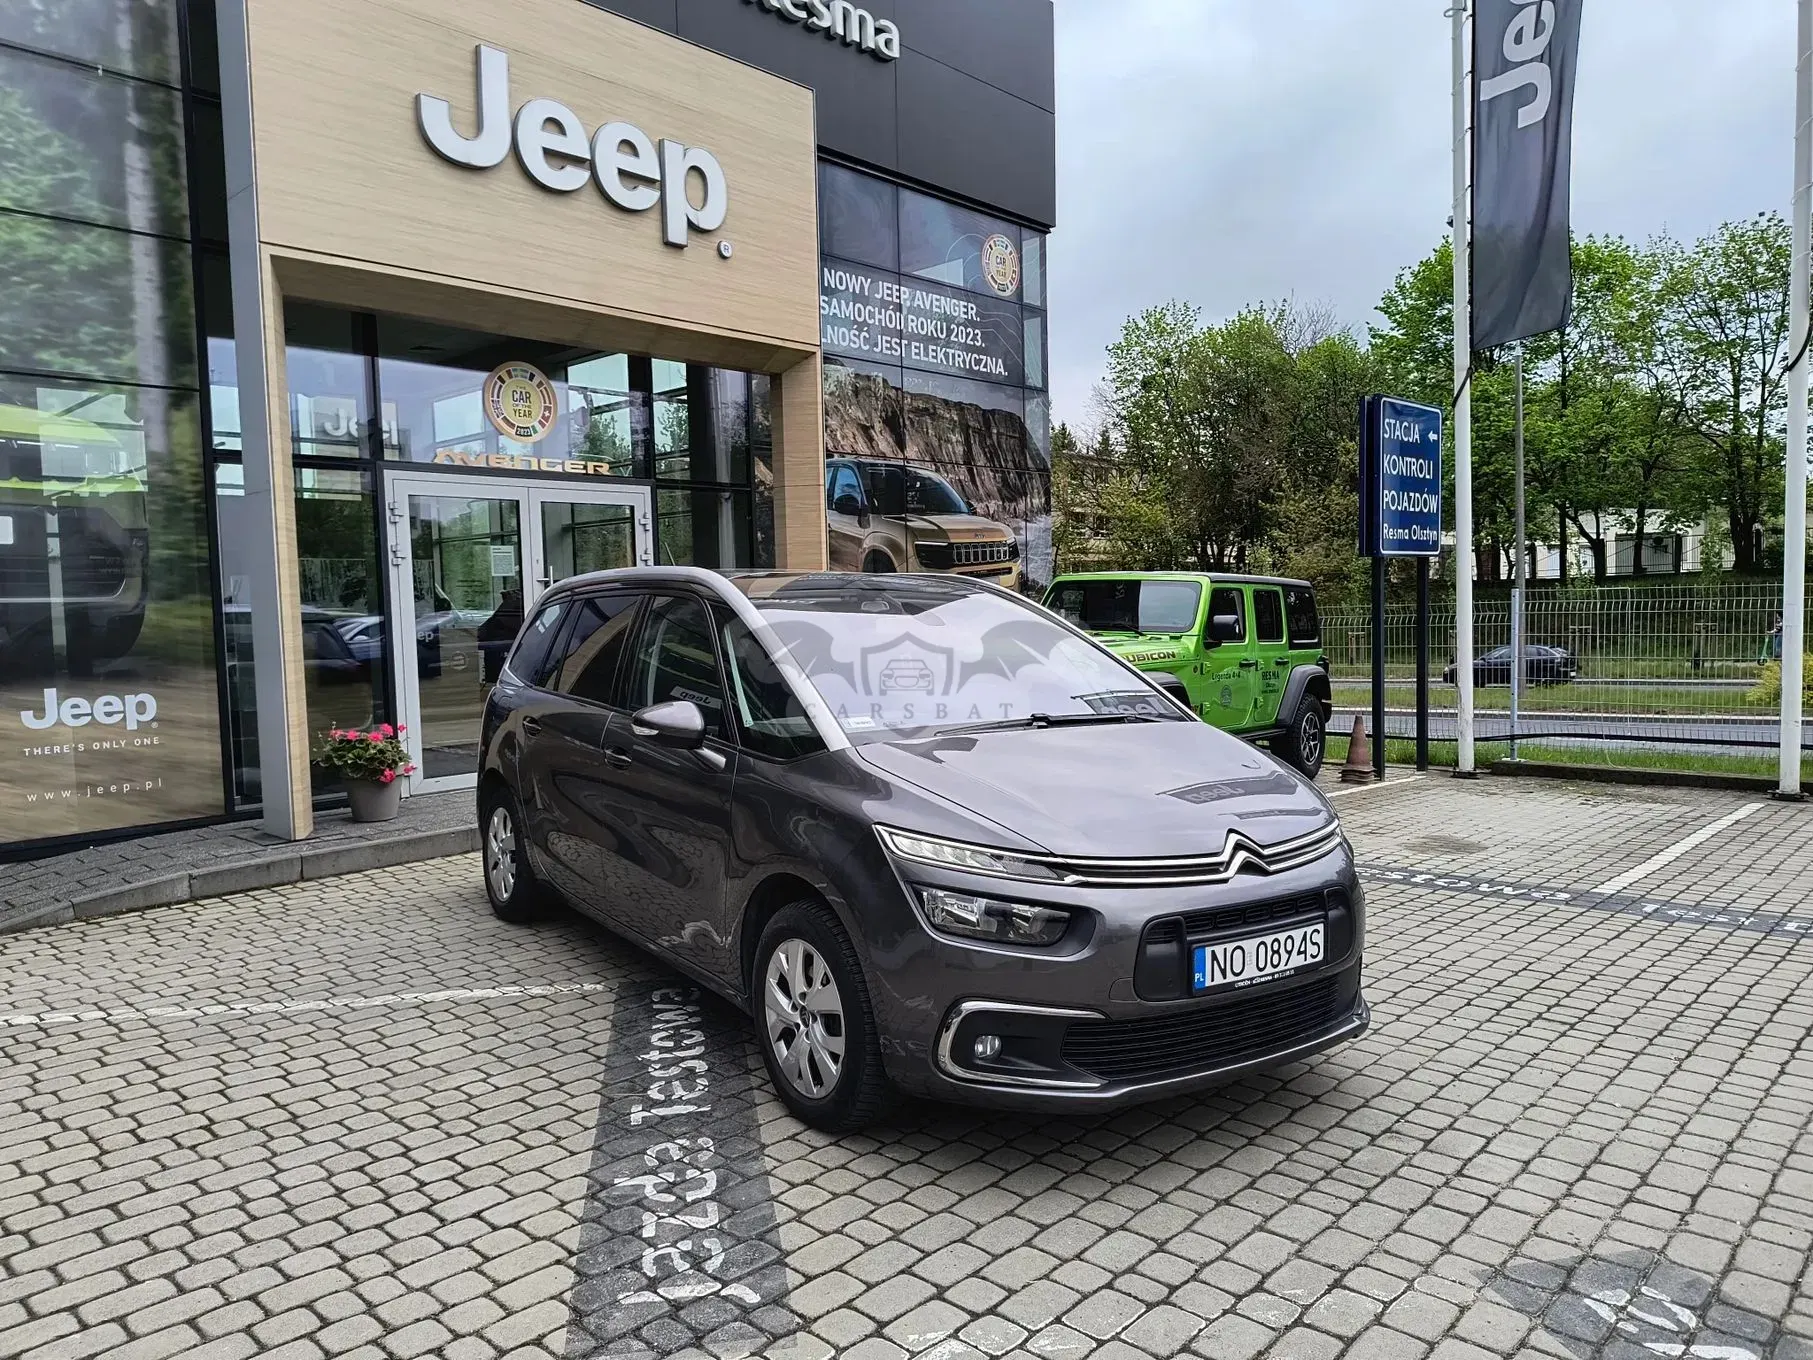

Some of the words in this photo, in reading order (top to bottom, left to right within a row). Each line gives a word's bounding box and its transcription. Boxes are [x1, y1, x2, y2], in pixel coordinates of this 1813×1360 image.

[742, 0, 899, 59] esma
[1480, 0, 1555, 129] Je
[415, 44, 728, 248] Jeep
[823, 267, 872, 296] NOWY
[913, 290, 980, 322] AVENGER.
[908, 314, 947, 339] ROKU
[950, 324, 985, 348] 2023.
[873, 334, 908, 358] JEST
[911, 341, 1008, 376] ELEKTRYCZNA.
[512, 389, 532, 404] CAR
[512, 408, 533, 419] YEAR
[1384, 418, 1420, 444] STACJA
[1383, 453, 1433, 480] KONTROLI
[1383, 488, 1438, 514] POJAZDÓW
[1383, 523, 1409, 541] Resma
[1411, 524, 1438, 545] Olsztyn
[20, 687, 157, 731] Jeep
[24, 743, 85, 757] THERE'S
[92, 739, 127, 750] ONLY
[134, 736, 160, 747] ONE
[27, 777, 162, 802] www.jeep.pl
[1210, 944, 1246, 983] NO
[1255, 928, 1321, 973] 0894S
[1194, 972, 1205, 983] PL
